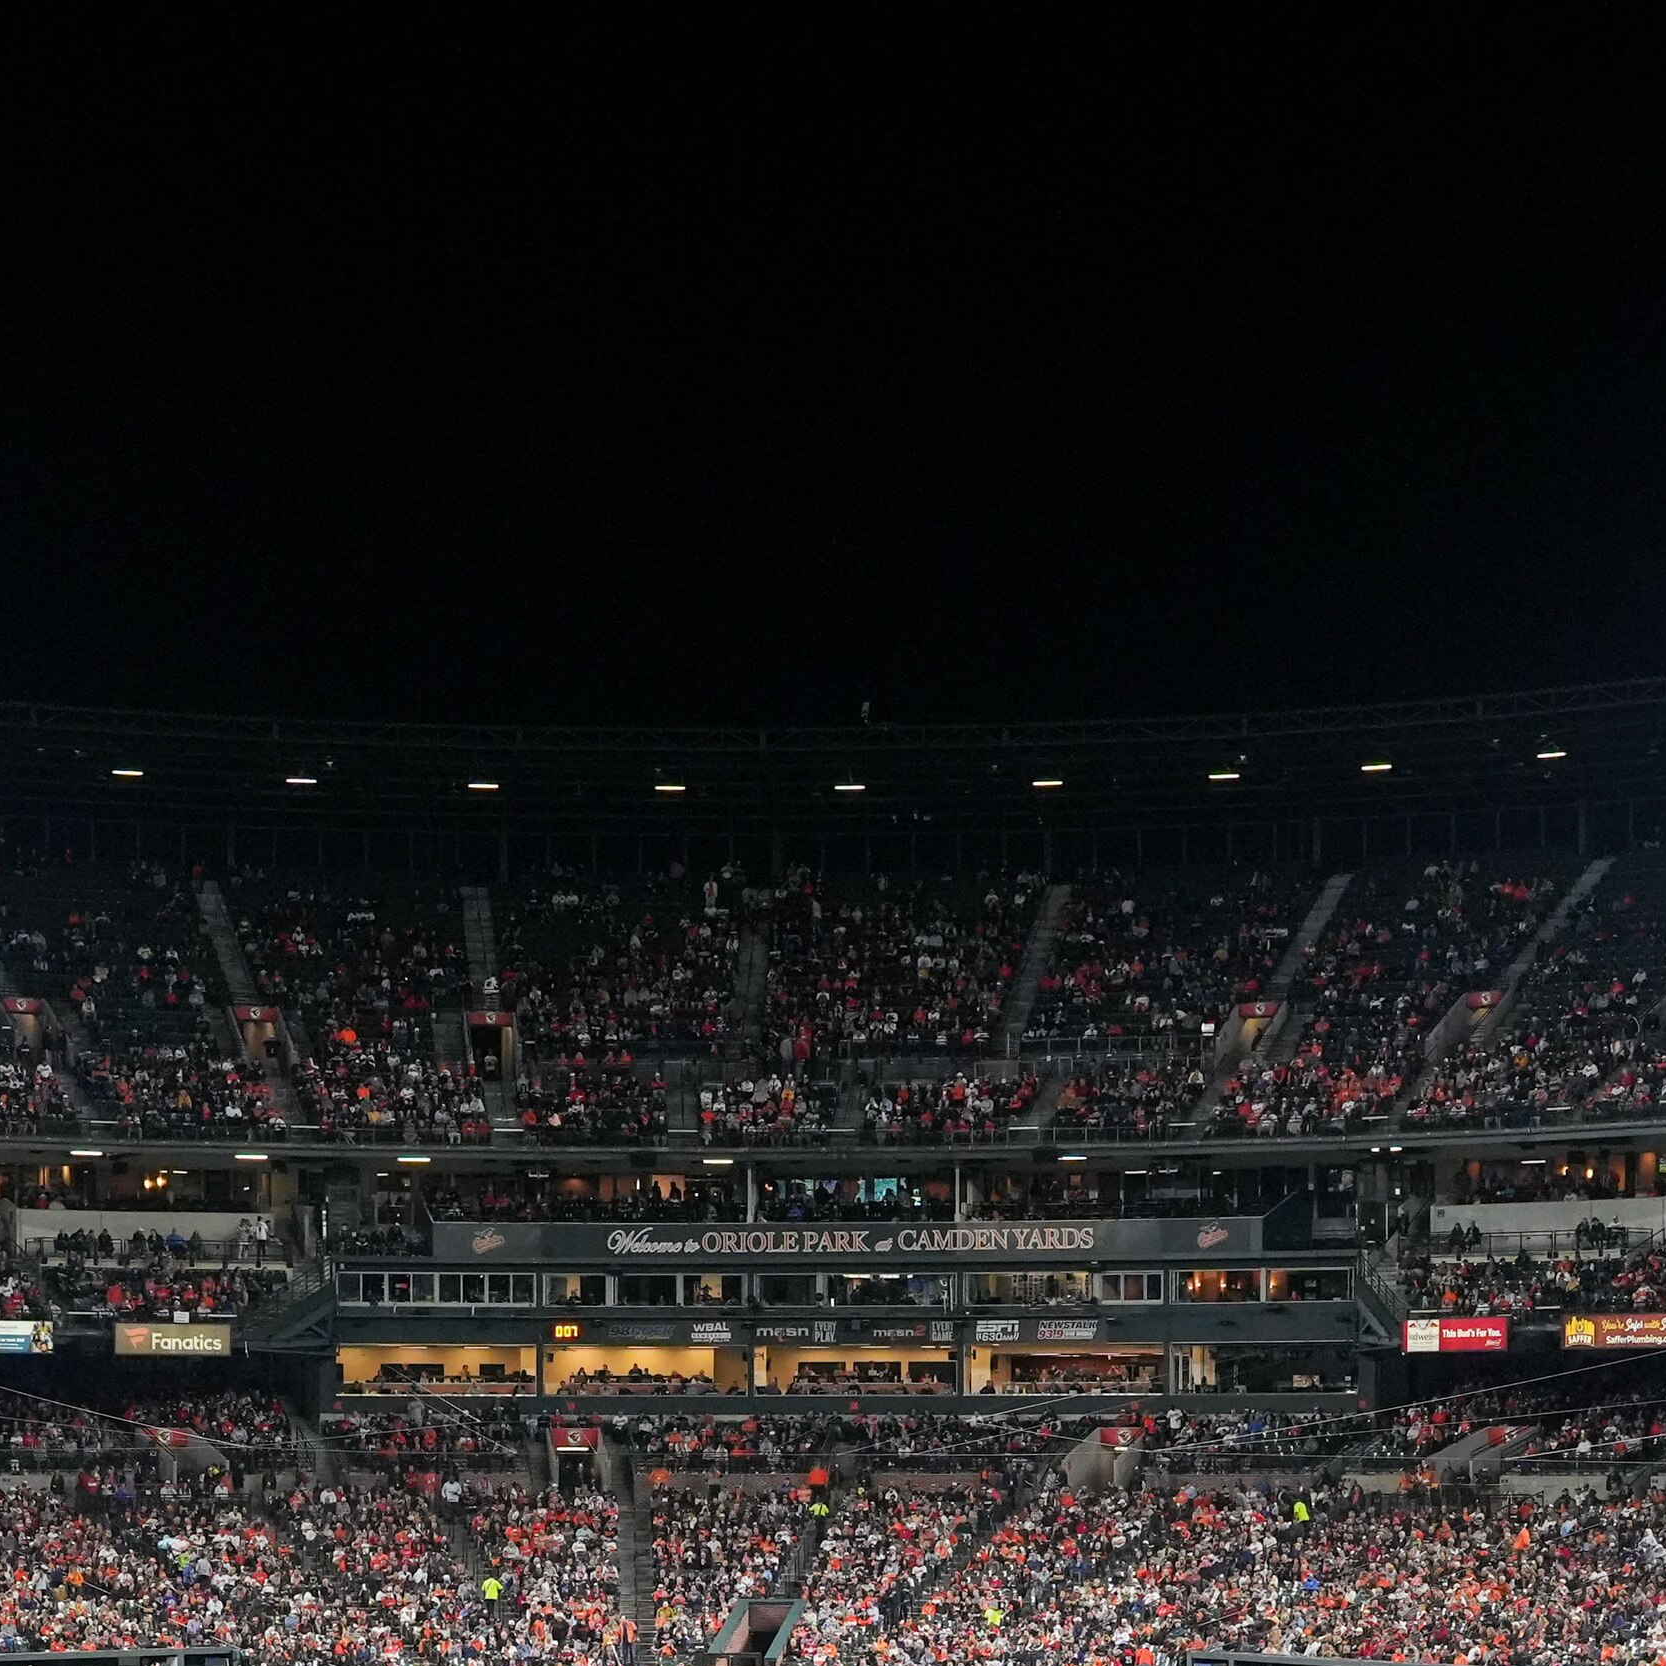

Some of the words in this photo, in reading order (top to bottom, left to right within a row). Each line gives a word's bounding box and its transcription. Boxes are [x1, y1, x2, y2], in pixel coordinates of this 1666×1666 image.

[606, 1226, 681, 1255] Welcome
[683, 1239, 700, 1253] to
[701, 1231, 799, 1253] ORIOLE
[802, 1230, 870, 1253] PARK
[874, 1236, 893, 1252] at
[897, 1229, 1010, 1252] CAMDEN
[1011, 1227, 1095, 1250] YARDS
[692, 1321, 730, 1332] WBAL
[814, 1321, 838, 1331] EVERY
[976, 1320, 1020, 1333] ESPN
[1039, 1320, 1098, 1329] NEWSTALK
[1644, 1319, 1660, 1329] with
[555, 1325, 578, 1338] 007
[756, 1327, 809, 1337] masn
[1442, 1328, 1457, 1338] This
[1457, 1328, 1475, 1338] Bud's
[1476, 1328, 1488, 1337] For
[151, 1332, 222, 1351] Fanatics
[1567, 1335, 1593, 1345] SAFFER
